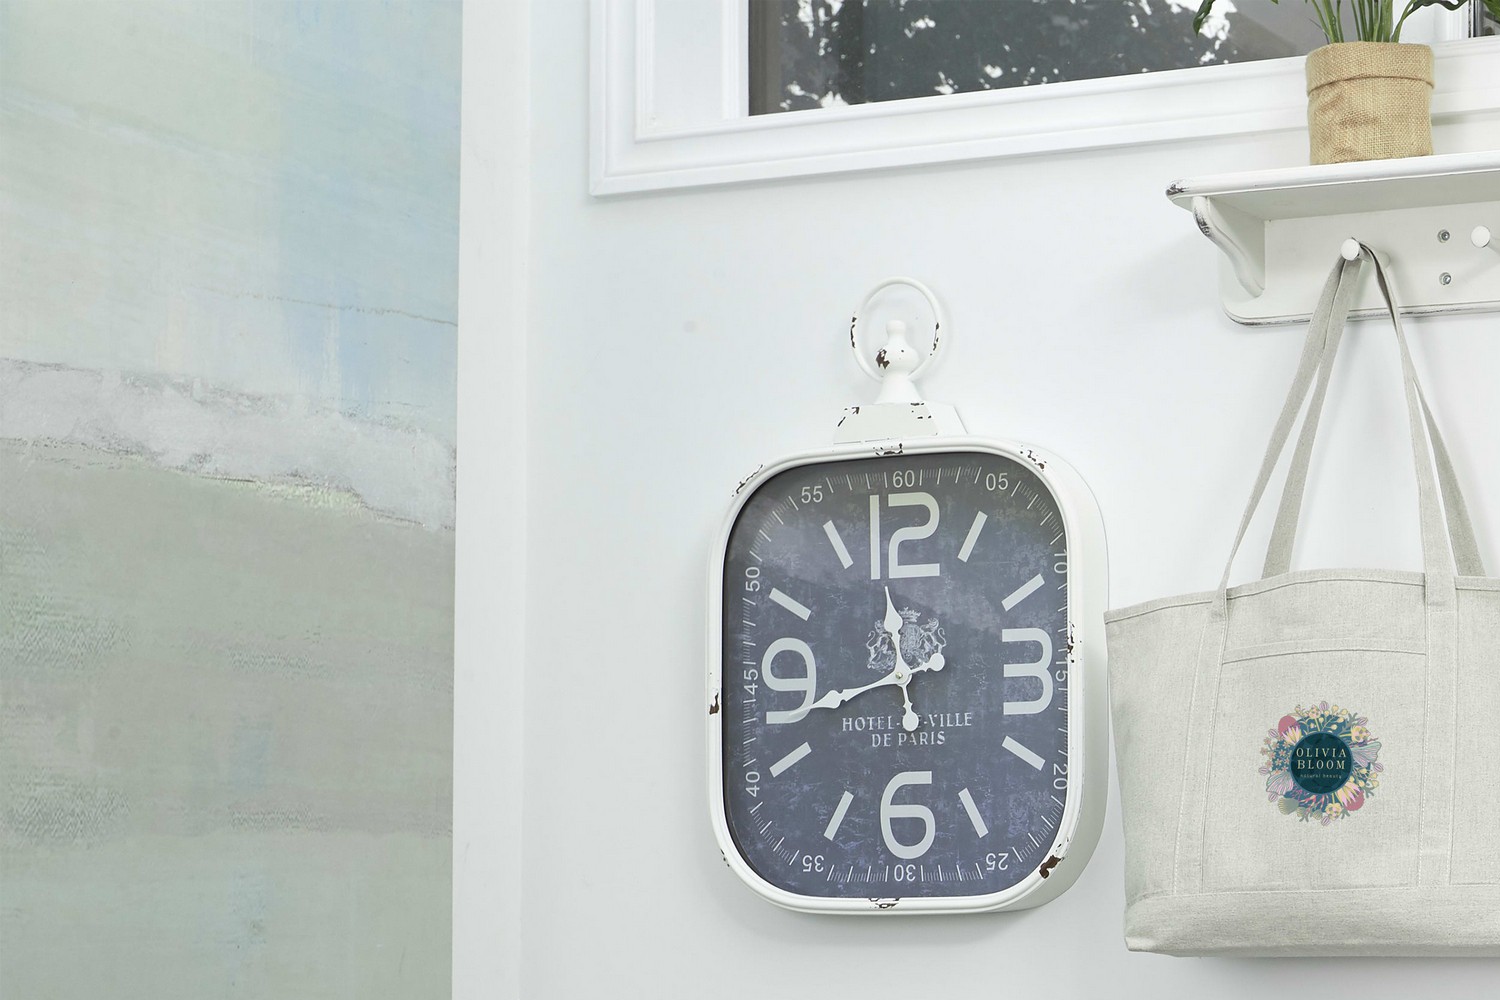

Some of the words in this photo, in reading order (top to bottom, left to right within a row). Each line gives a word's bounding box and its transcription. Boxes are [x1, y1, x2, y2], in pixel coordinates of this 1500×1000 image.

[892, 470, 916, 488] 60
[985, 472, 1010, 491] 05
[801, 485, 824, 504] 55
[869, 491, 941, 580] 12
[1053, 549, 1069, 574] 10
[745, 566, 761, 592] 50
[761, 637, 818, 725] 9
[1001, 627, 1054, 716] 3
[1055, 657, 1069, 682] 15
[743, 669, 759, 696] 45
[871, 733, 892, 748] DE
[897, 731, 946, 747] PARIS
[1296, 747, 1347, 758] OLIVIA
[1296, 759, 1346, 770] BLOOM
[745, 771, 761, 798] 40
[1053, 762, 1069, 790] 20
[880, 770, 936, 860] 6
[802, 855, 825, 873] 35
[893, 864, 917, 883] 30
[985, 852, 1009, 871] 25
